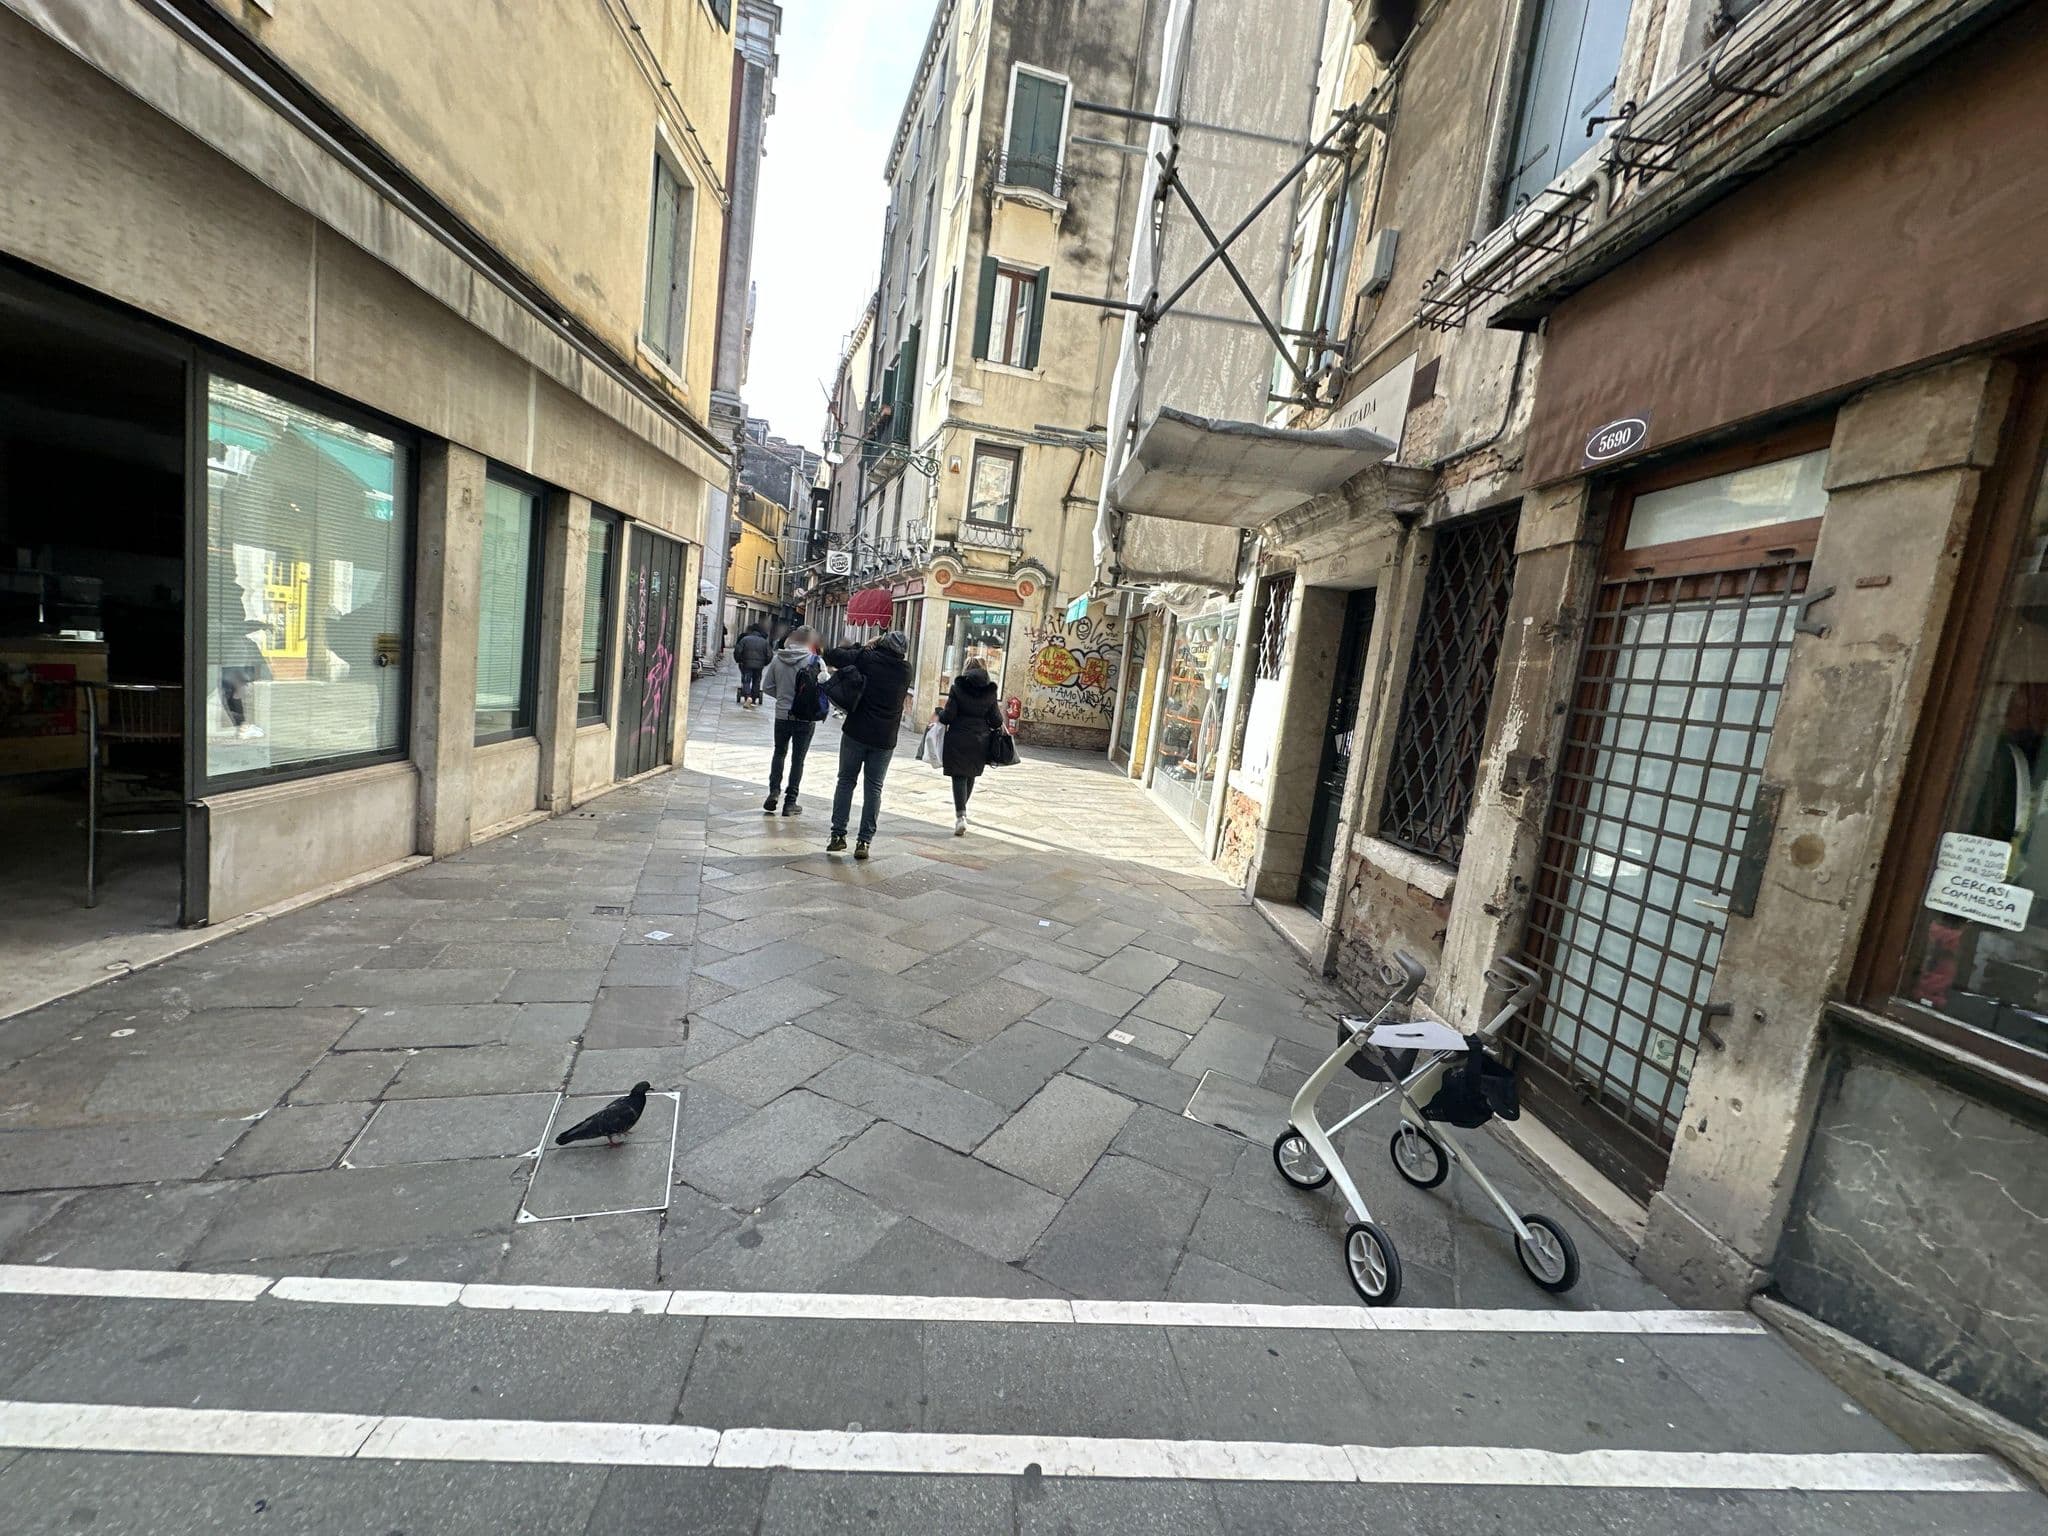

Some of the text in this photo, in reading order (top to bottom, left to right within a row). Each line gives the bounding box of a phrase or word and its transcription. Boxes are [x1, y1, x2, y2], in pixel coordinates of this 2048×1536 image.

[1598, 427, 1631, 453] 5690
[1941, 886, 2016, 913] COMMESSA
[1950, 875, 2010, 899] CERCASI
